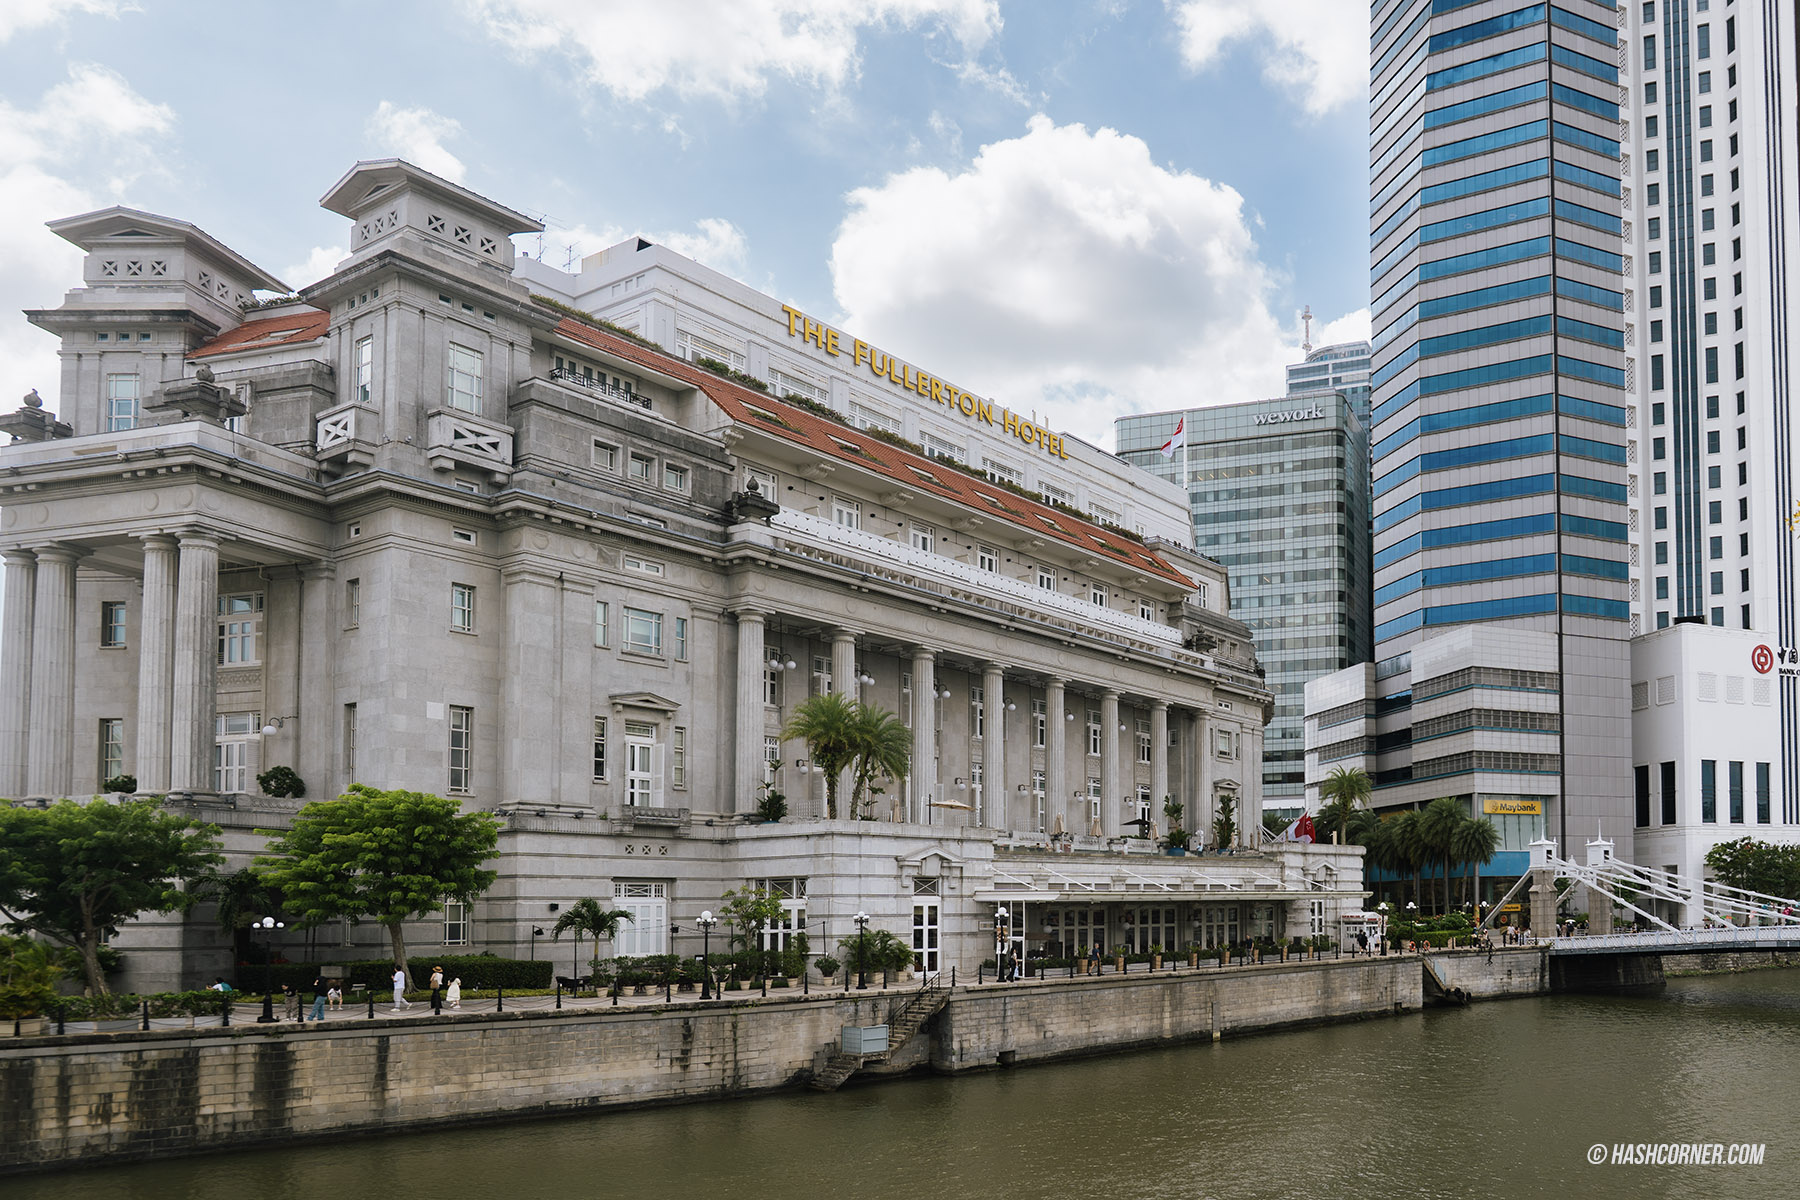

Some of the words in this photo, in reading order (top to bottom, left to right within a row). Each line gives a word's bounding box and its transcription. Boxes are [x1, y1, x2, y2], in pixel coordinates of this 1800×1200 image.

[782, 304, 840, 357] THE
[853, 338, 993, 428] FULLERTON
[1003, 408, 1069, 460] HOTEL
[1252, 402, 1325, 425] wework
[1778, 668, 1796, 676] BANK
[1499, 803, 1537, 813] Maybank
